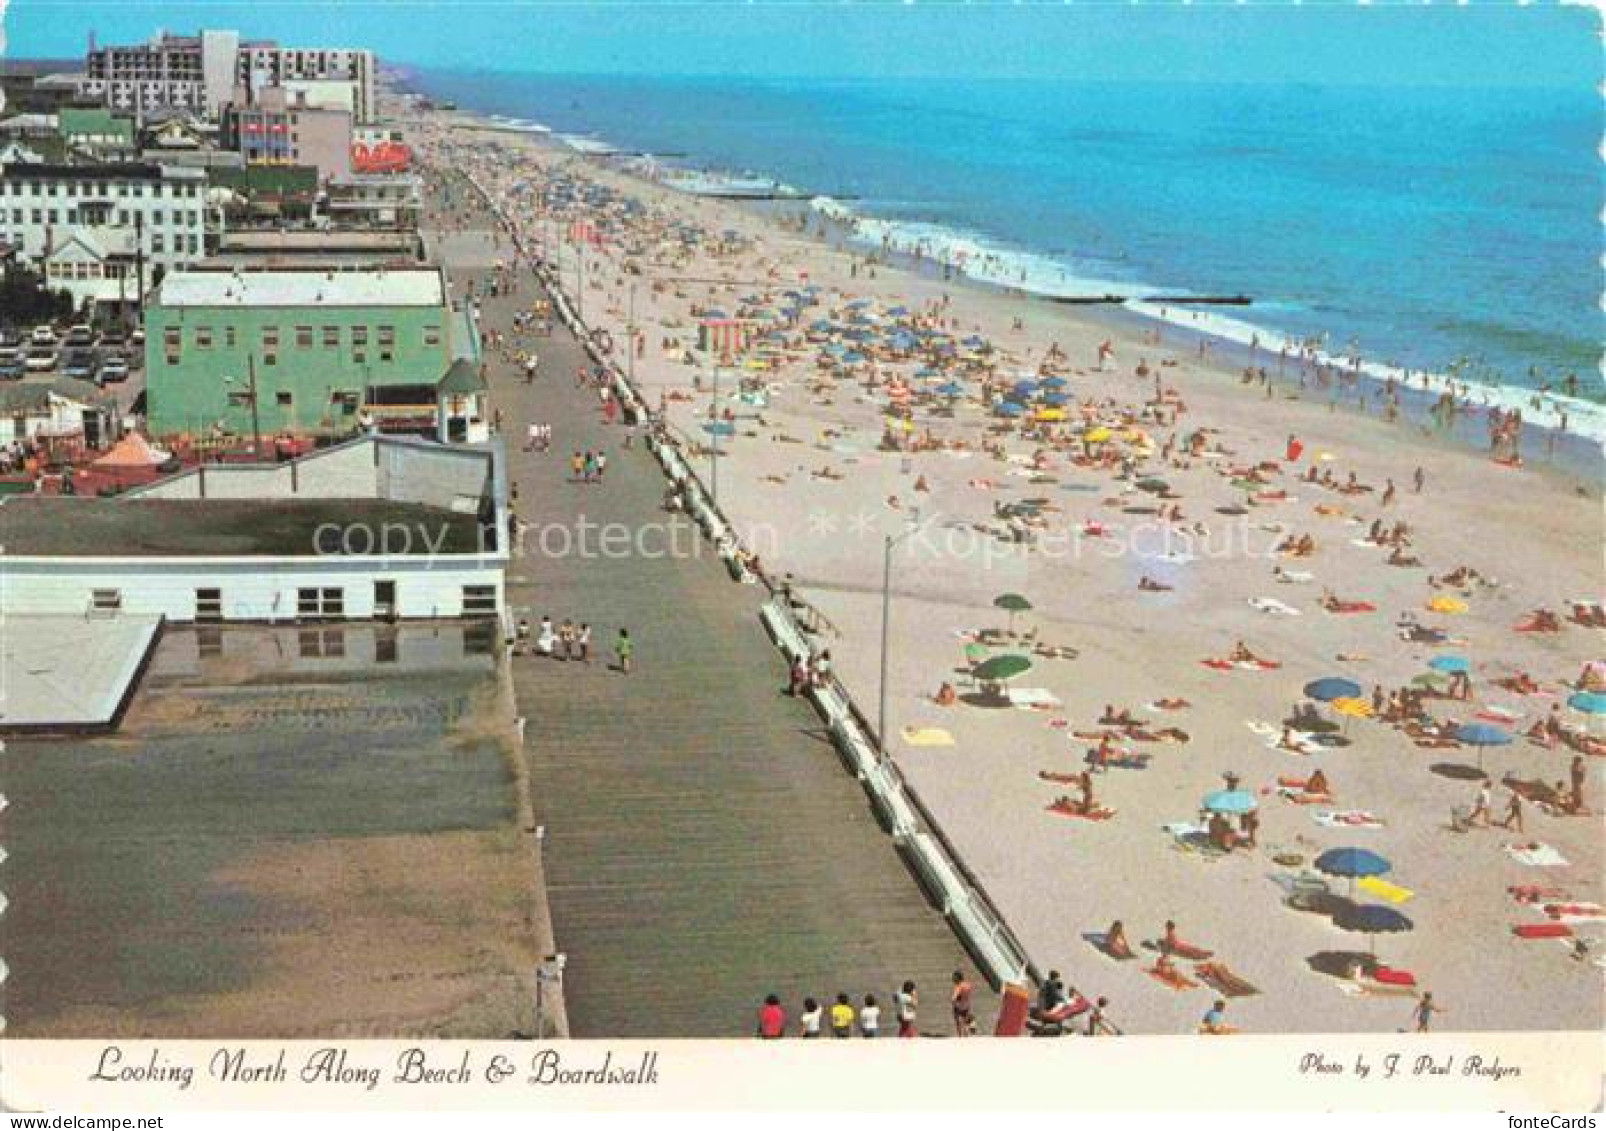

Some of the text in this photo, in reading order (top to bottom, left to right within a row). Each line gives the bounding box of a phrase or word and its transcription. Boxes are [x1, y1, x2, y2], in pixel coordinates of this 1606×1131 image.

[89, 1046, 658, 1091] Looking North Along Beach & Boardwalk
[1300, 1052, 1343, 1075] Photo
[1354, 1053, 1371, 1079] by
[1412, 1054, 1453, 1076] Paul
